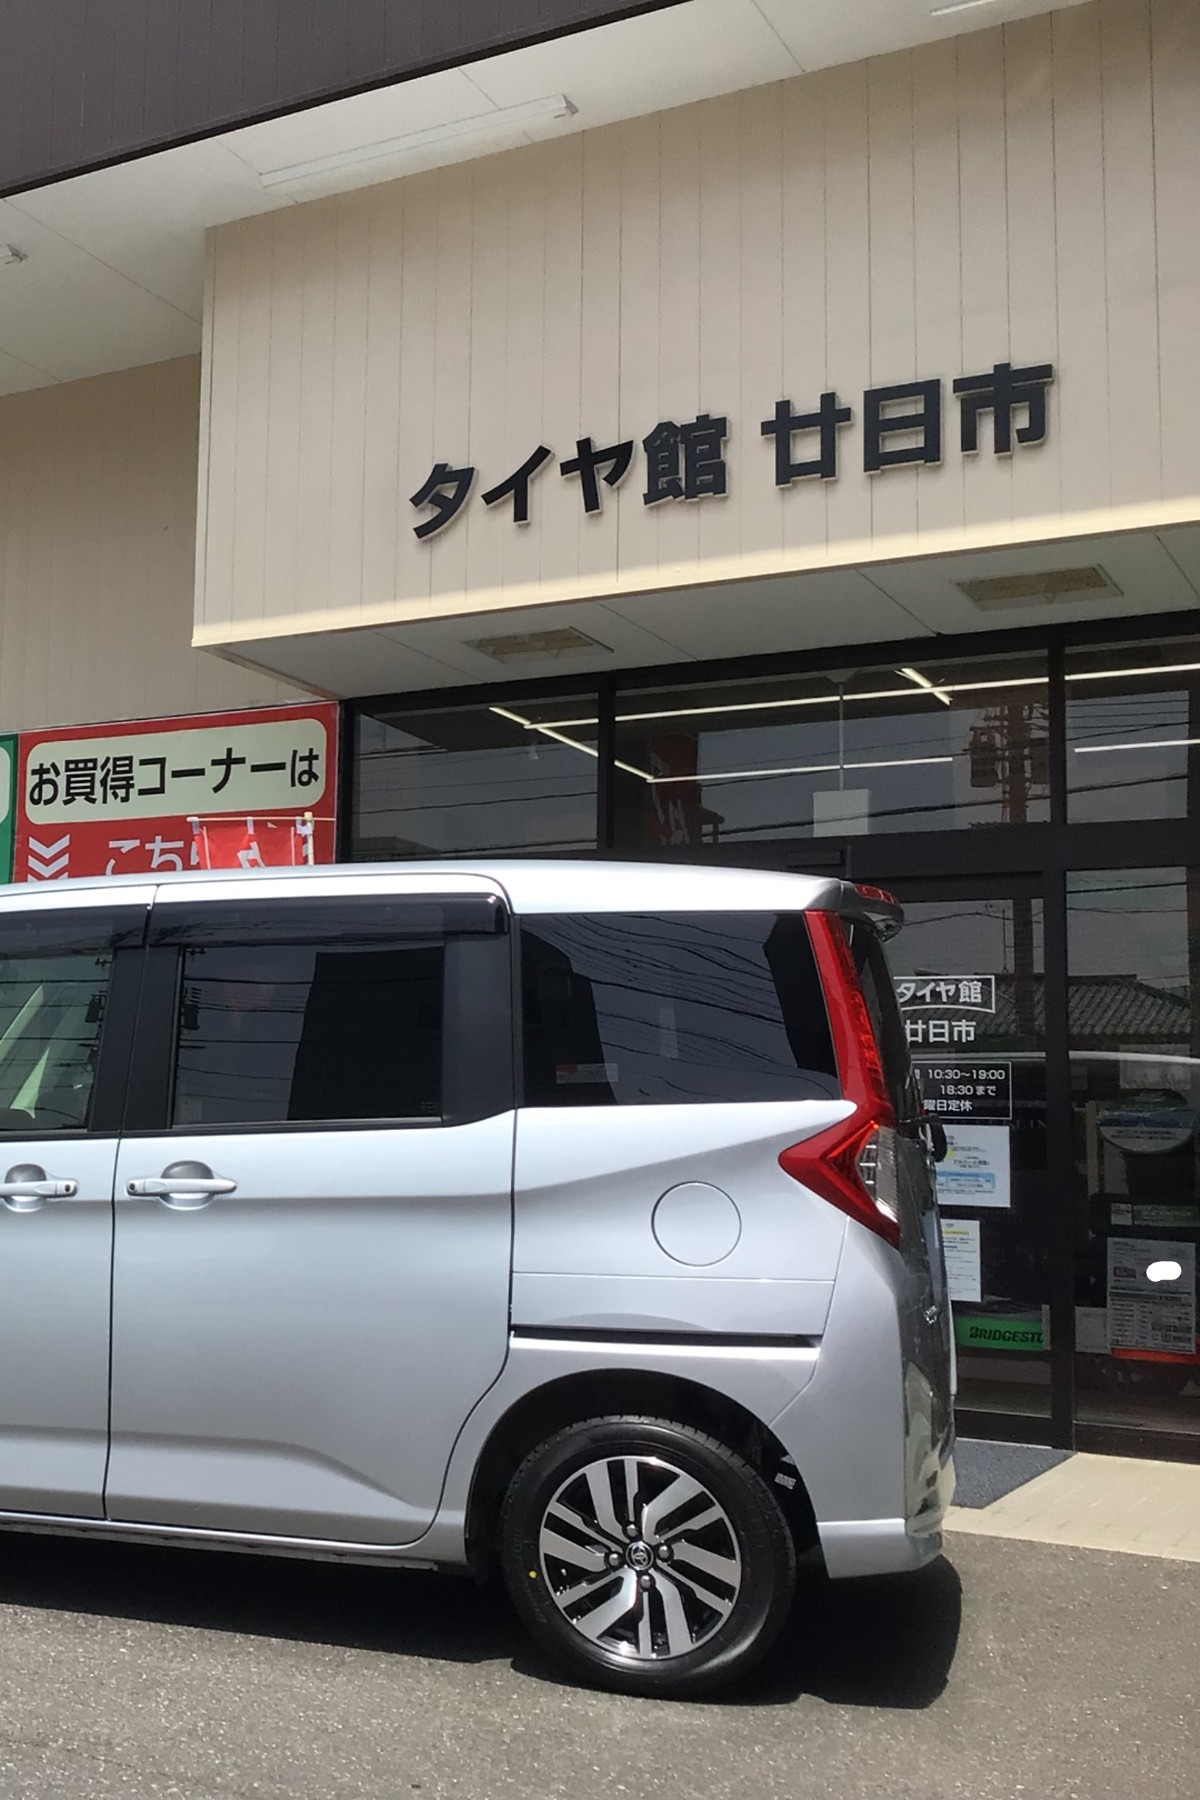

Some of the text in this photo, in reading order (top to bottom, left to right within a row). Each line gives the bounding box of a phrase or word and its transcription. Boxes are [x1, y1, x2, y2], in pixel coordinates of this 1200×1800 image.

[409, 362, 1054, 541] タイヤ館 廿日市
[29, 746, 320, 807] お買得コーナーは
[105, 835, 199, 876] こち
[896, 980, 982, 1003] タイヤ館
[905, 1019, 976, 1043] 廿日市
